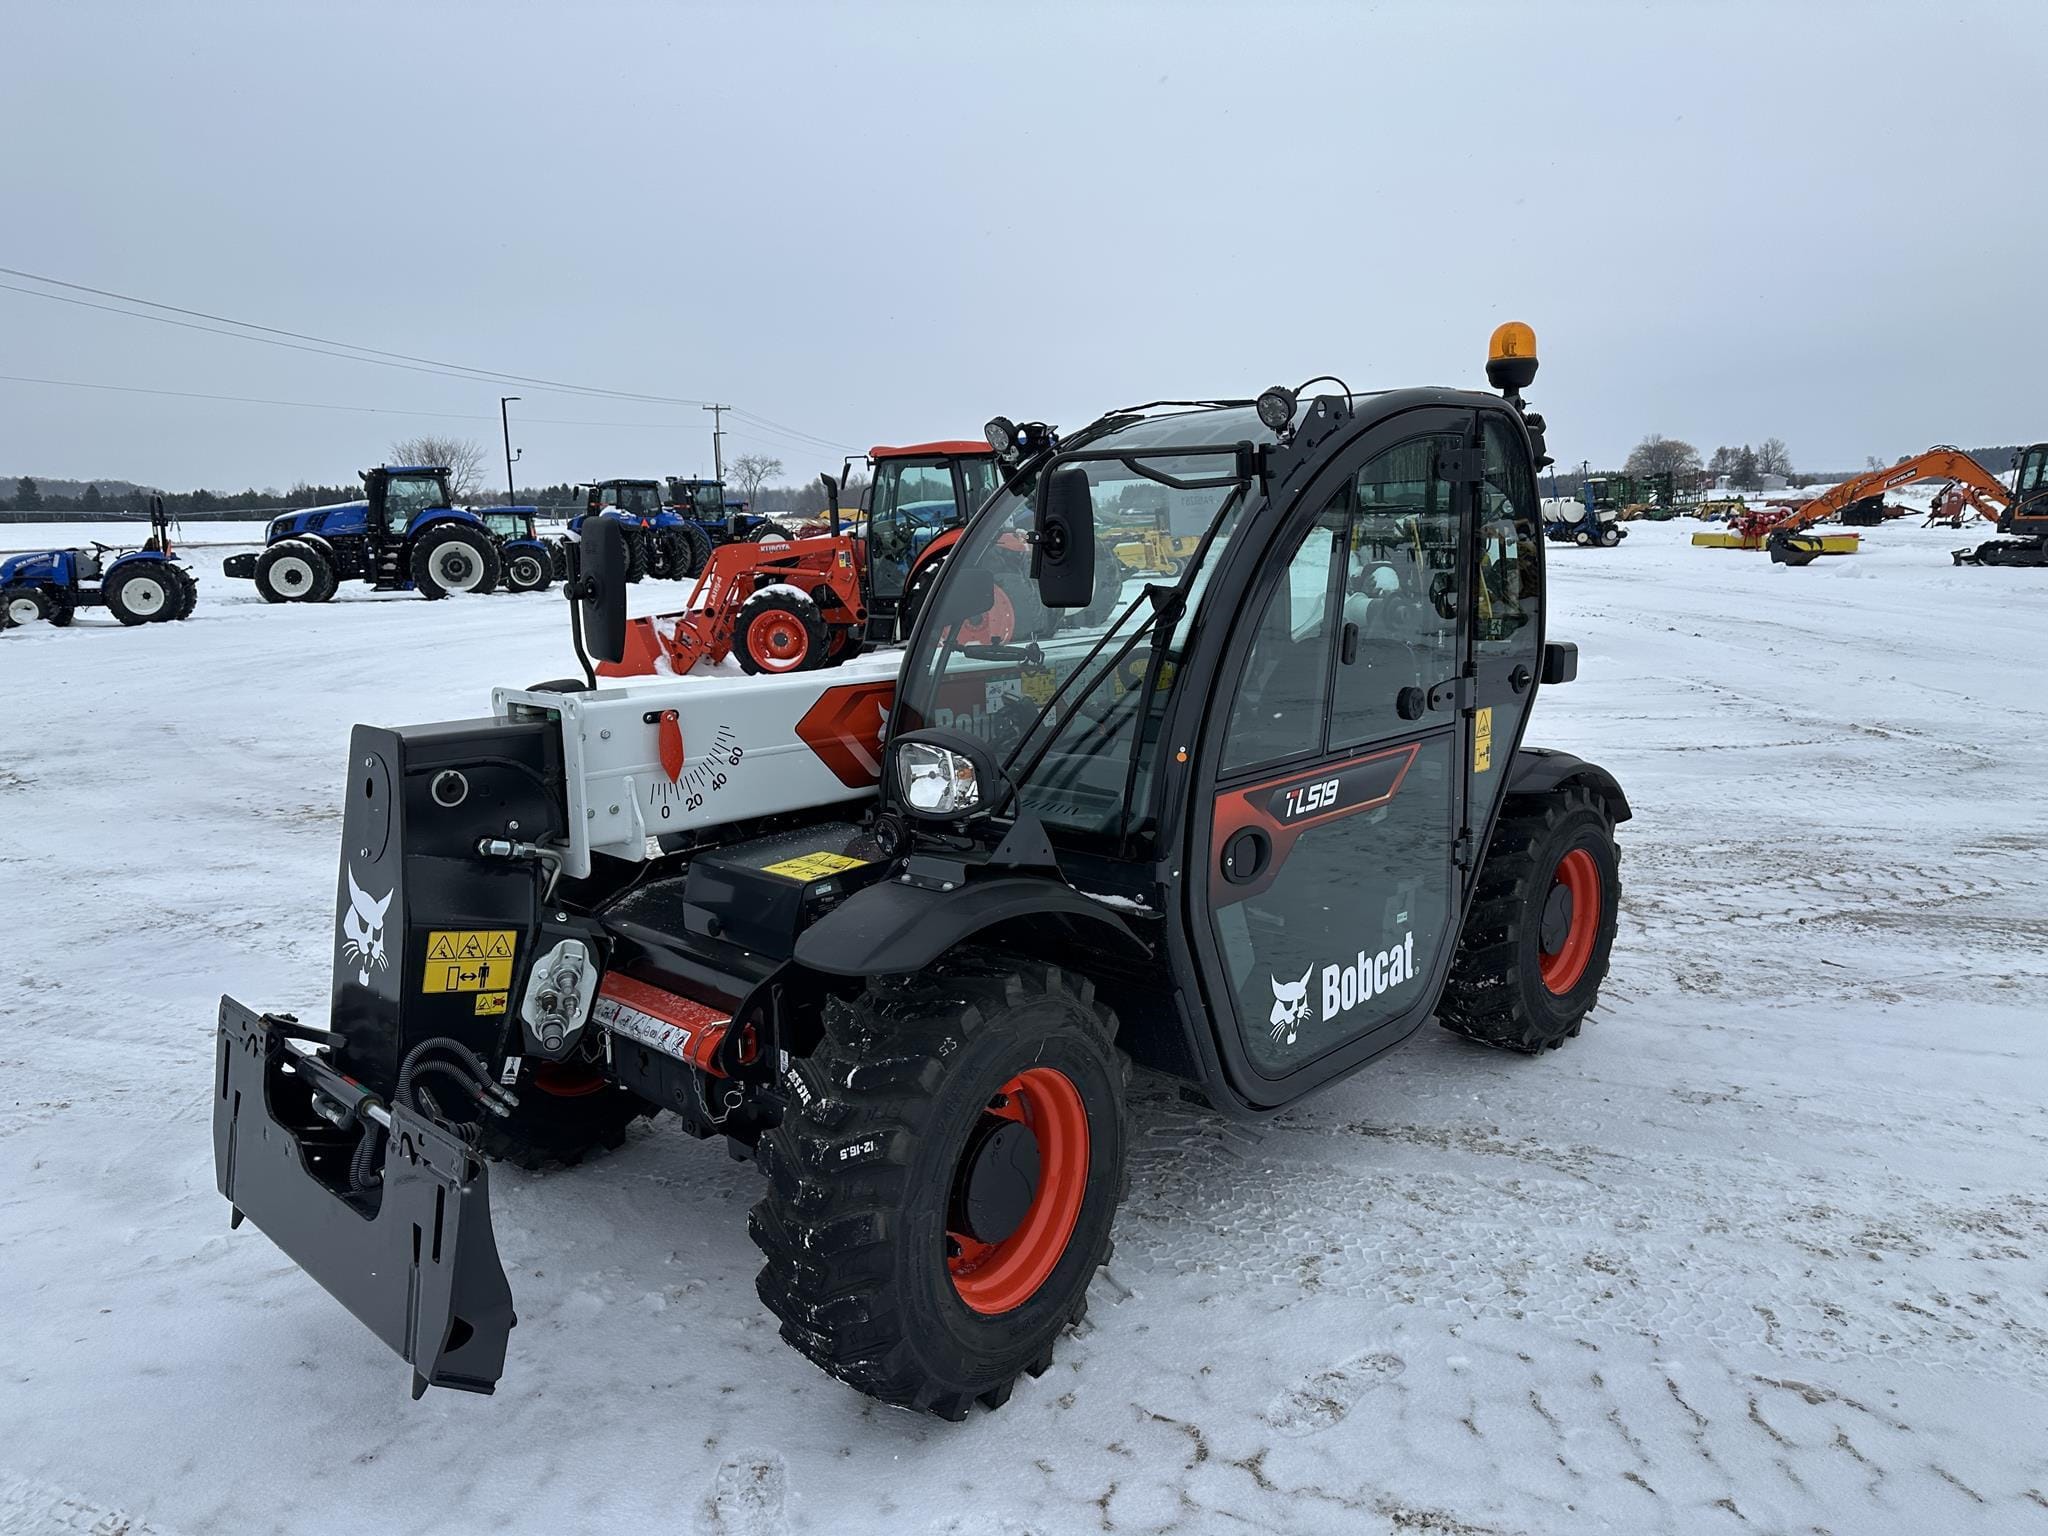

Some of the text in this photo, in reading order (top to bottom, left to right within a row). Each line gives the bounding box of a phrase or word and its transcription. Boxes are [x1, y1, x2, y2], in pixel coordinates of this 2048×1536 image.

[760, 544, 791, 552] KUBOTA
[728, 746, 744, 766] 60
[711, 772, 727, 791] 40
[661, 805, 671, 819] 0
[685, 793, 703, 812] 20
[1322, 930, 1414, 1022] Bobcat
[839, 1140, 874, 1161] 12-16.5
